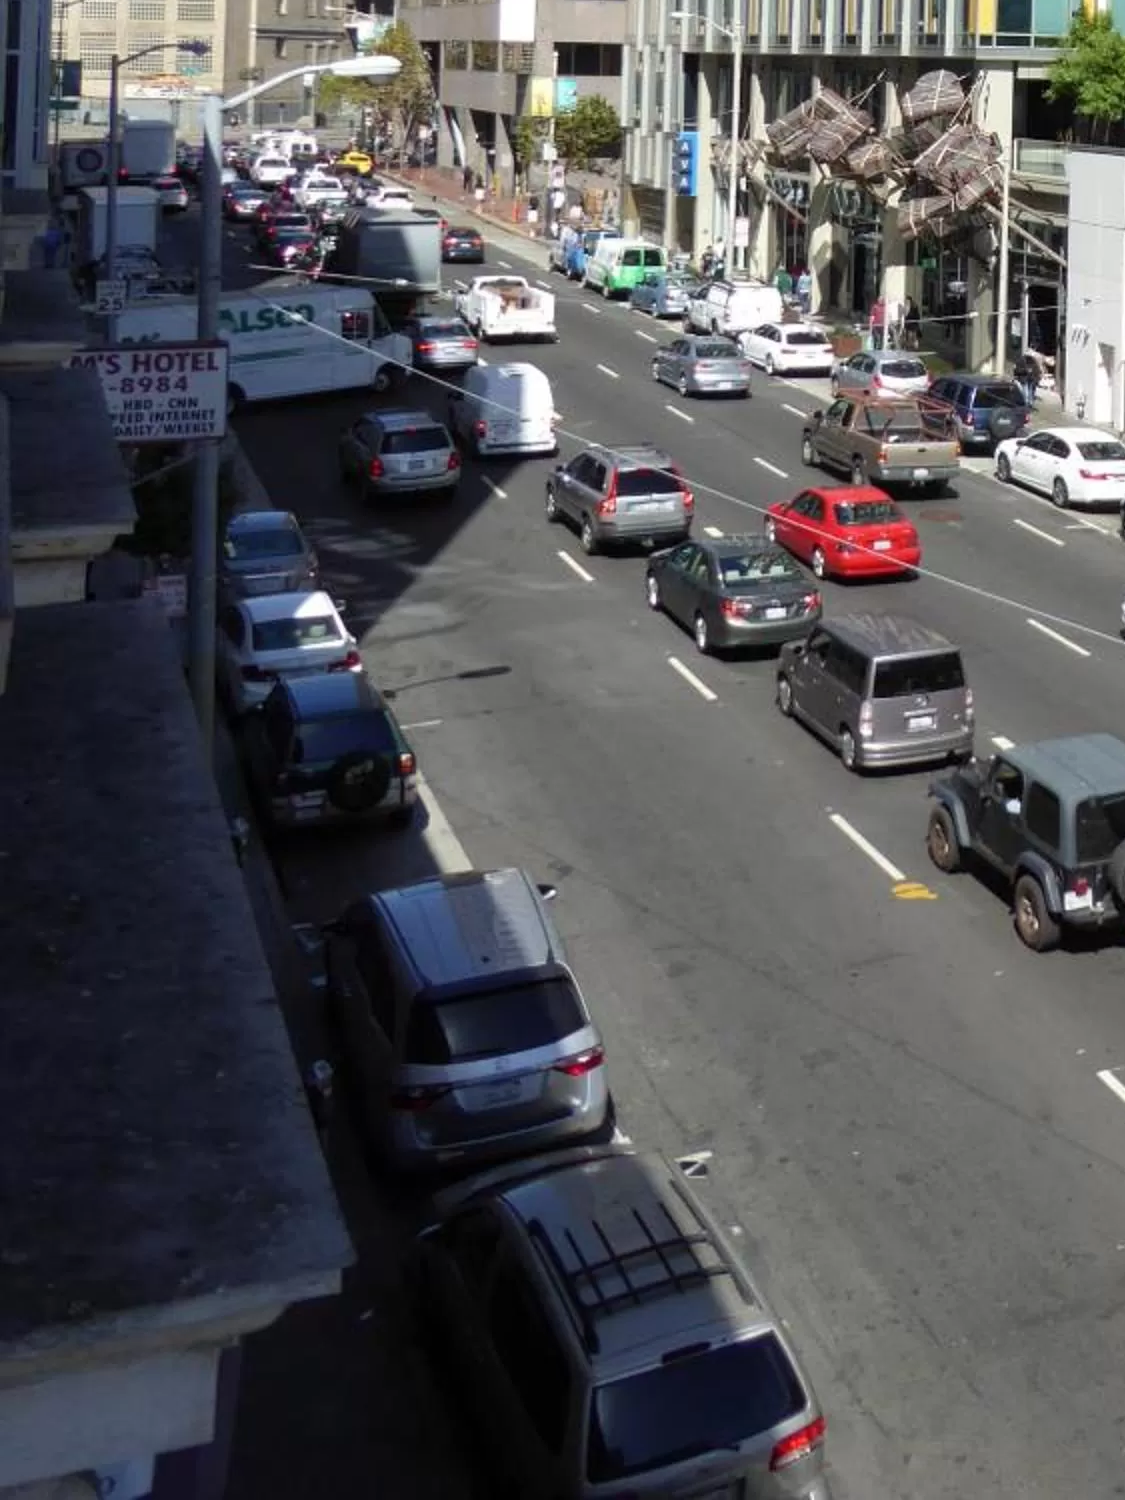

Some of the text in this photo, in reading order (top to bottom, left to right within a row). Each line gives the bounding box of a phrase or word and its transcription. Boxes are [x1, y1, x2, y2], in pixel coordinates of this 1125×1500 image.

[680, 141, 689, 186] AVA
[99, 298, 122, 311] 25
[131, 351, 219, 373] HOTEL
[167, 397, 199, 409] CNN
[149, 409, 216, 423] INTERNET
